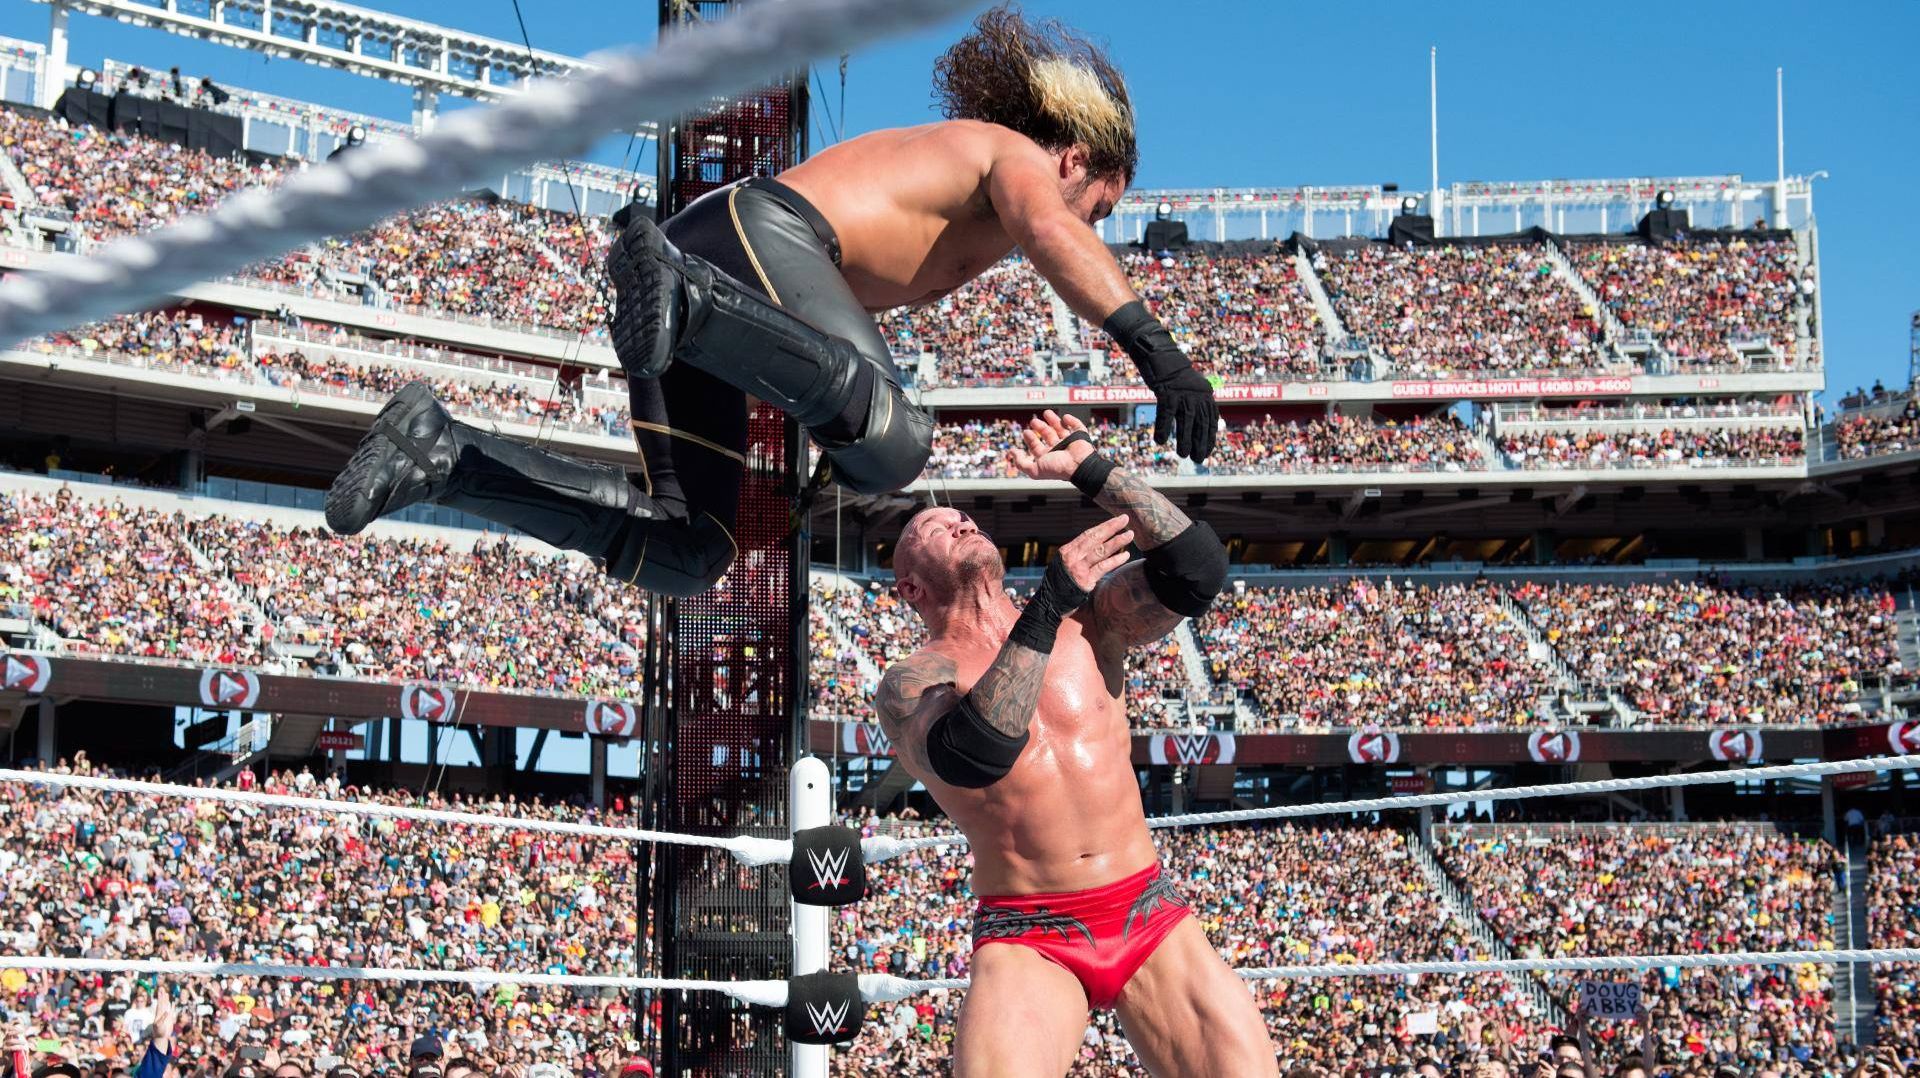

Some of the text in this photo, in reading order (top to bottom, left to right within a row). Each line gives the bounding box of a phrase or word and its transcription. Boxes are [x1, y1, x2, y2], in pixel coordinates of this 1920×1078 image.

[1073, 388, 1104, 400] FREE
[1393, 383, 1429, 395] GUEST
[1431, 382, 1486, 395] SERVICES
[1487, 381, 1539, 393] HOTLINE
[1586, 982, 1639, 998] DOUG
[1586, 998, 1637, 1014] ABBY
